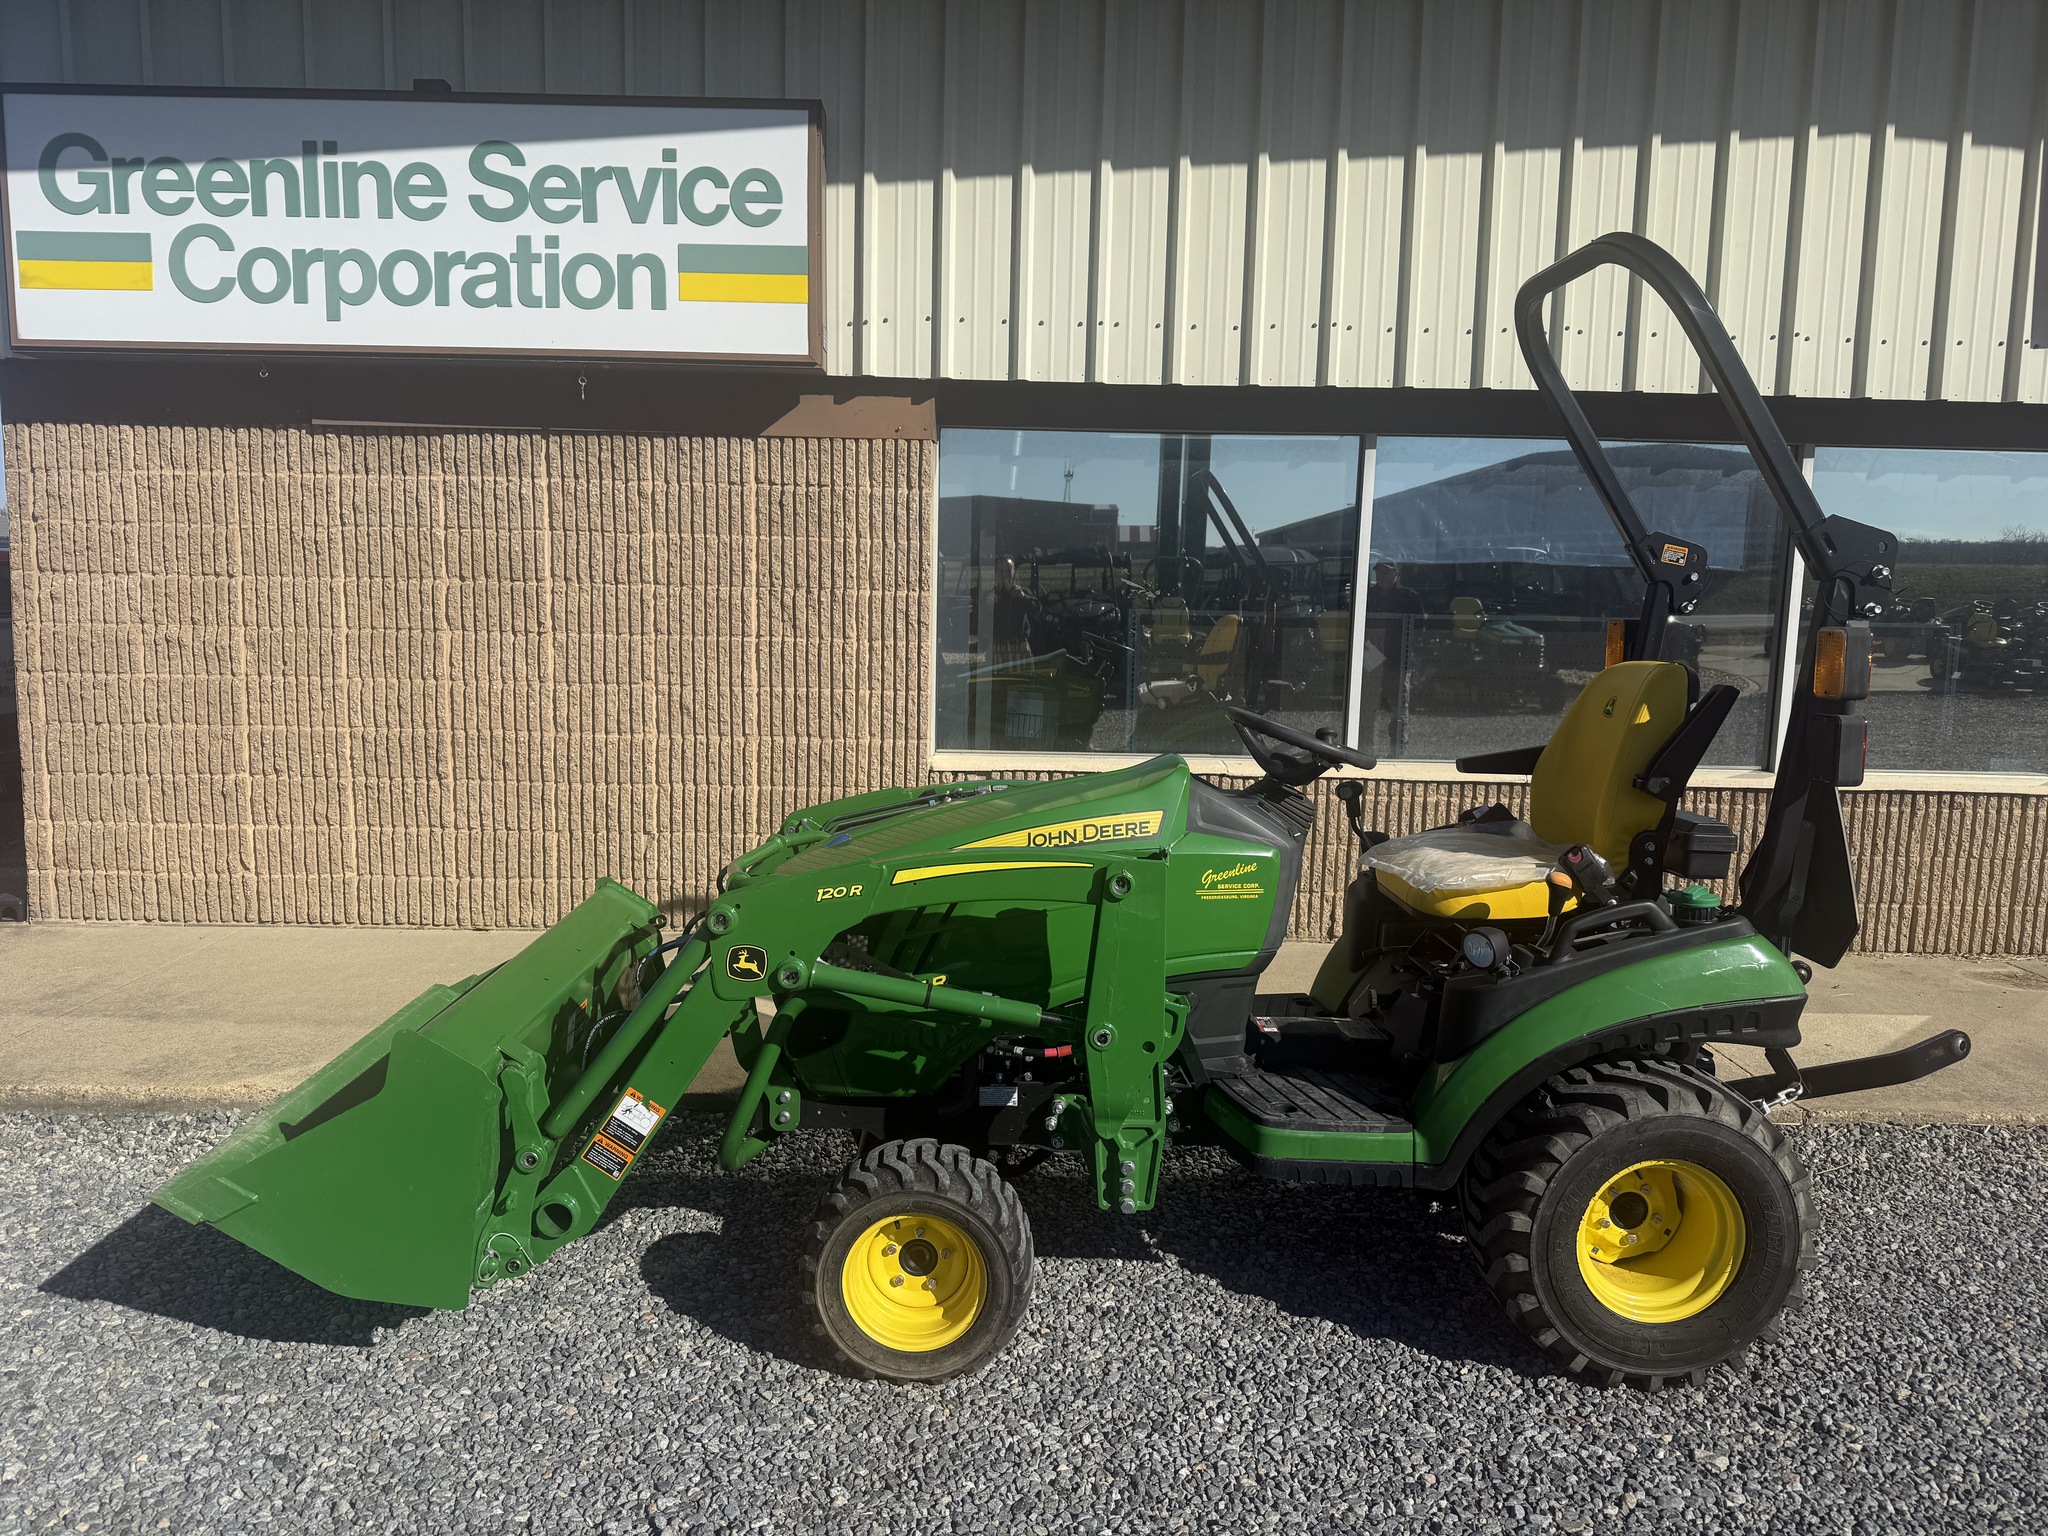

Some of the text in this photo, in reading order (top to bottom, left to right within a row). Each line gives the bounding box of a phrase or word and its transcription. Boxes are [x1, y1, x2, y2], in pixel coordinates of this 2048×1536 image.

[37, 132, 784, 228] Greenline Service
[168, 223, 668, 322] Corporation
[1026, 820, 1151, 848] JOHN DEERE
[1201, 862, 1258, 889] Greenline
[816, 884, 863, 902] 120 R
[604, 1141, 629, 1159] WARNING
